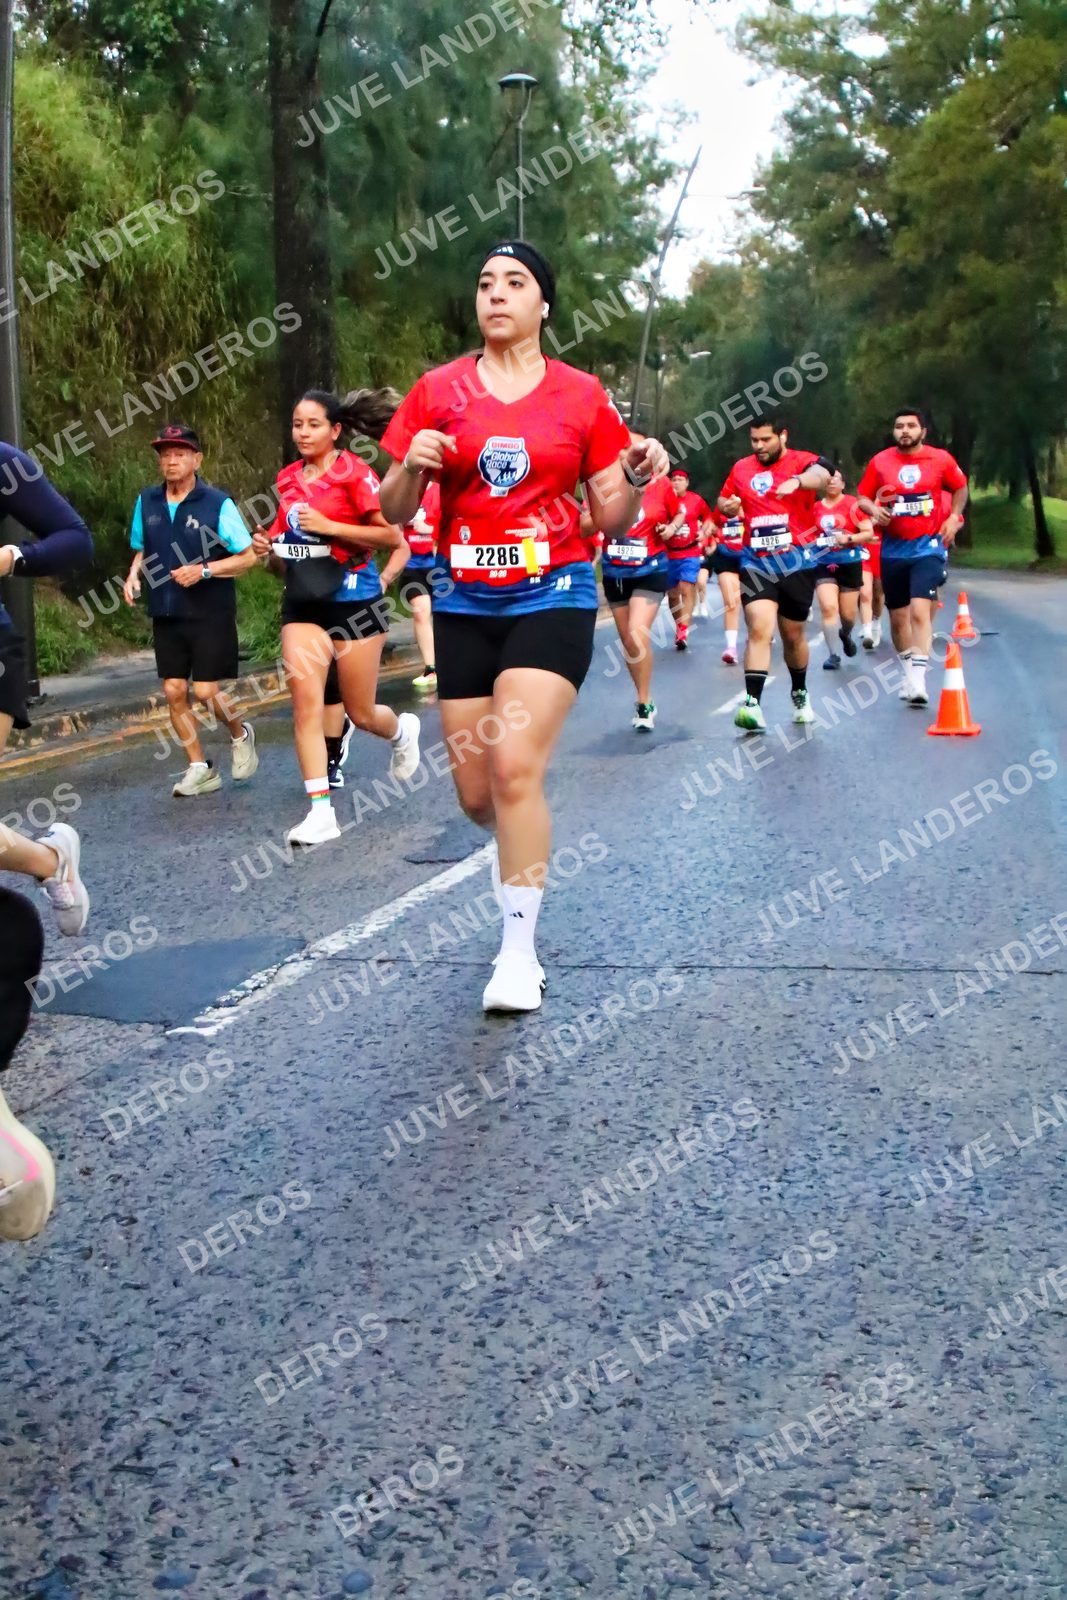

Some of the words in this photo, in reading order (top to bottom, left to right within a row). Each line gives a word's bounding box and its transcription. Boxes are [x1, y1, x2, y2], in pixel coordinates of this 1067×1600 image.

[491, 451, 518, 461] Global
[486, 460, 507, 469] Race
[761, 536, 780, 546] 4926
[288, 545, 310, 557] 4973
[475, 546, 519, 566] 2286
